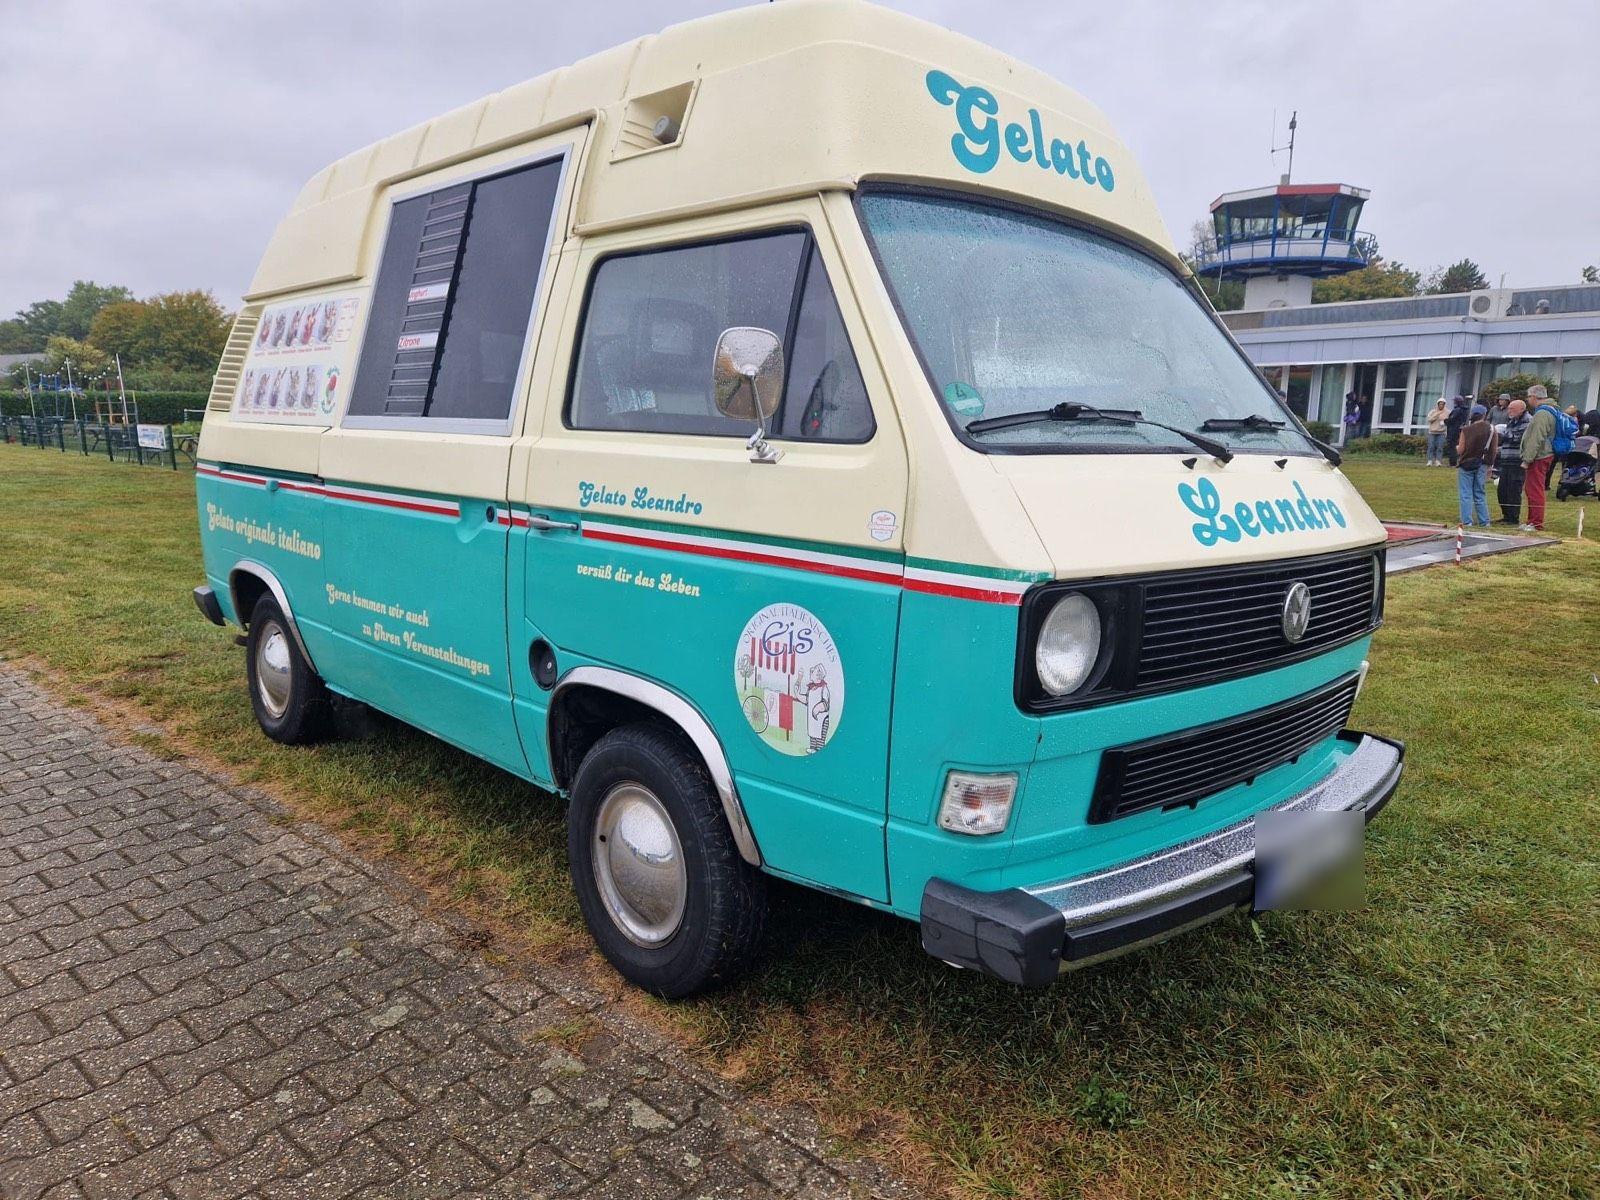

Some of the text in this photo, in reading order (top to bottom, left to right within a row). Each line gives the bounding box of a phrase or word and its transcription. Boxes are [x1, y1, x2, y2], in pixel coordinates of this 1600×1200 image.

[926, 70, 1114, 192] Gelato
[579, 481, 702, 515] Gelato Leandro
[1178, 477, 1346, 546] Leandro
[207, 502, 320, 559] Gelato originale italiano
[577, 564, 700, 597] versüß dir das Leben
[326, 583, 429, 627] Gerne kommen wir auch
[362, 622, 491, 675] zu Ihren Veranstaltungen
[762, 621, 814, 657] Eis
